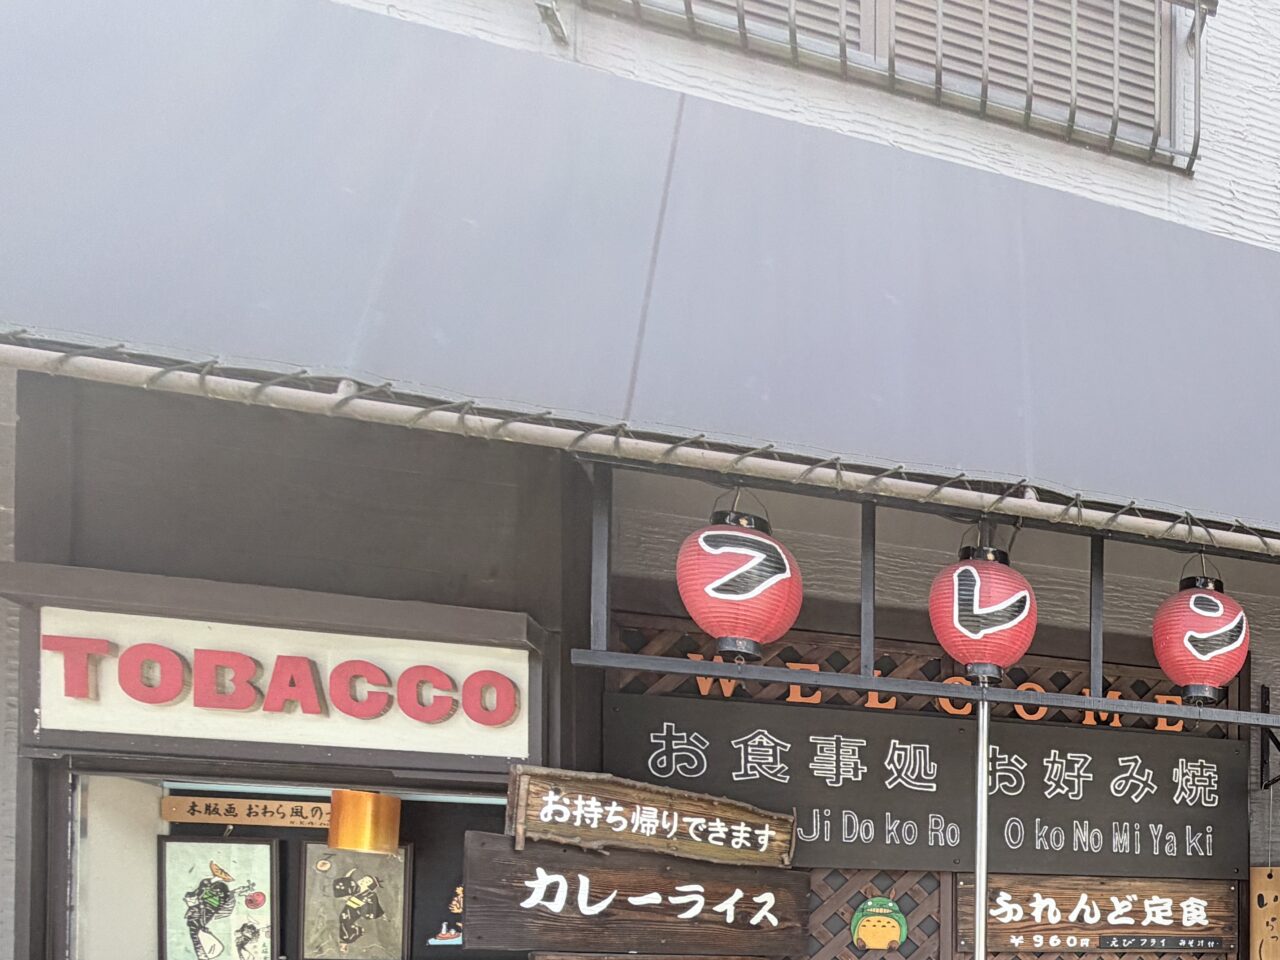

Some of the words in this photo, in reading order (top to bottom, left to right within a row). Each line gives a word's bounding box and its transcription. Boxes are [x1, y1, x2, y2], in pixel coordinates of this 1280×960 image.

[42, 634, 520, 727] TOBACCO
[539, 790, 776, 852] お持ち帰りできます
[520, 866, 779, 927] カレーライス
[989, 891, 1210, 927] ふれんど定食
